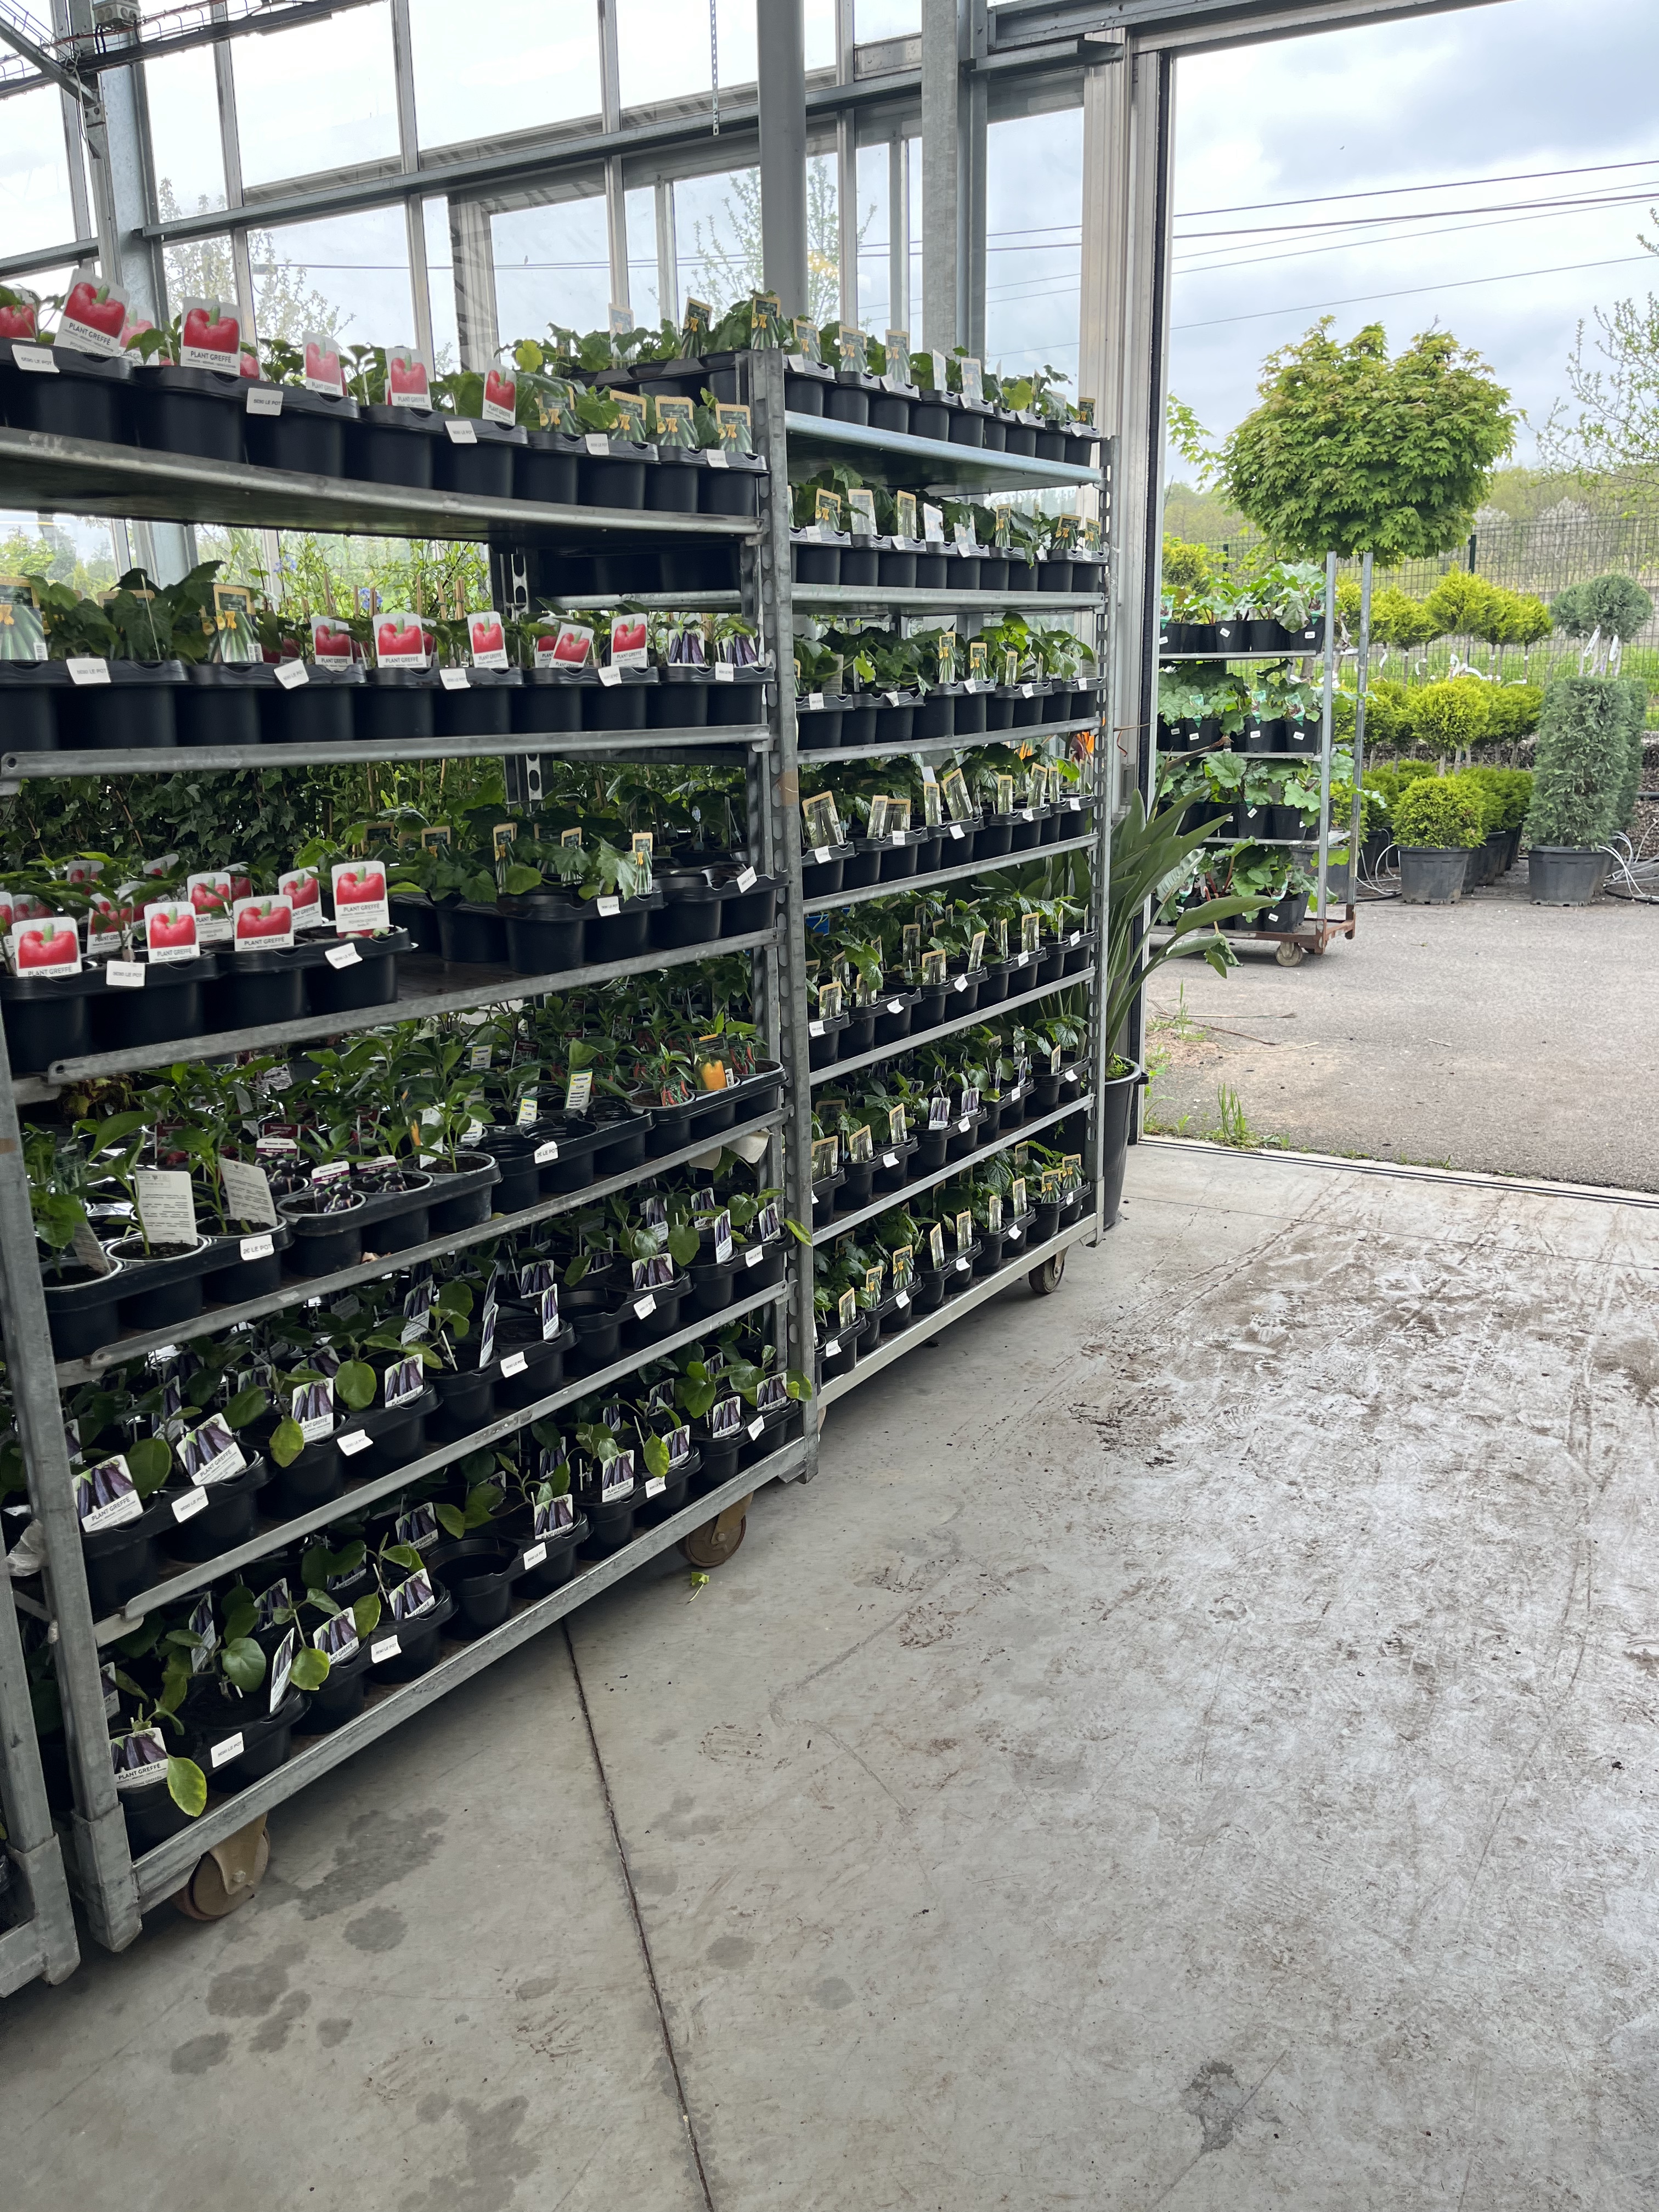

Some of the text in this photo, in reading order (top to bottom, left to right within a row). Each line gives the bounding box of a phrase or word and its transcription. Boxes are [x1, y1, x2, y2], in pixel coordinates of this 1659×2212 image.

[69, 322, 111, 346] PLANT GREFFÉ
[190, 351, 232, 363] PLANT GREFFÉ
[312, 381, 324, 390] PLANT
[488, 404, 498, 413] PLANT
[28, 966, 72, 977] PLANT GREFFÉ
[392, 1397, 404, 1406] PLANT
[199, 1464, 213, 1478] PLANT
[214, 1449, 232, 1466] GREFFÉ
[91, 1508, 109, 1521] PLANT
[109, 1496, 131, 1511] GREFFÉ
[329, 1644, 354, 1663] ANT GREFFÉ
[119, 1770, 137, 1780] PLANT
[138, 1763, 161, 1774] GREFFÉ
